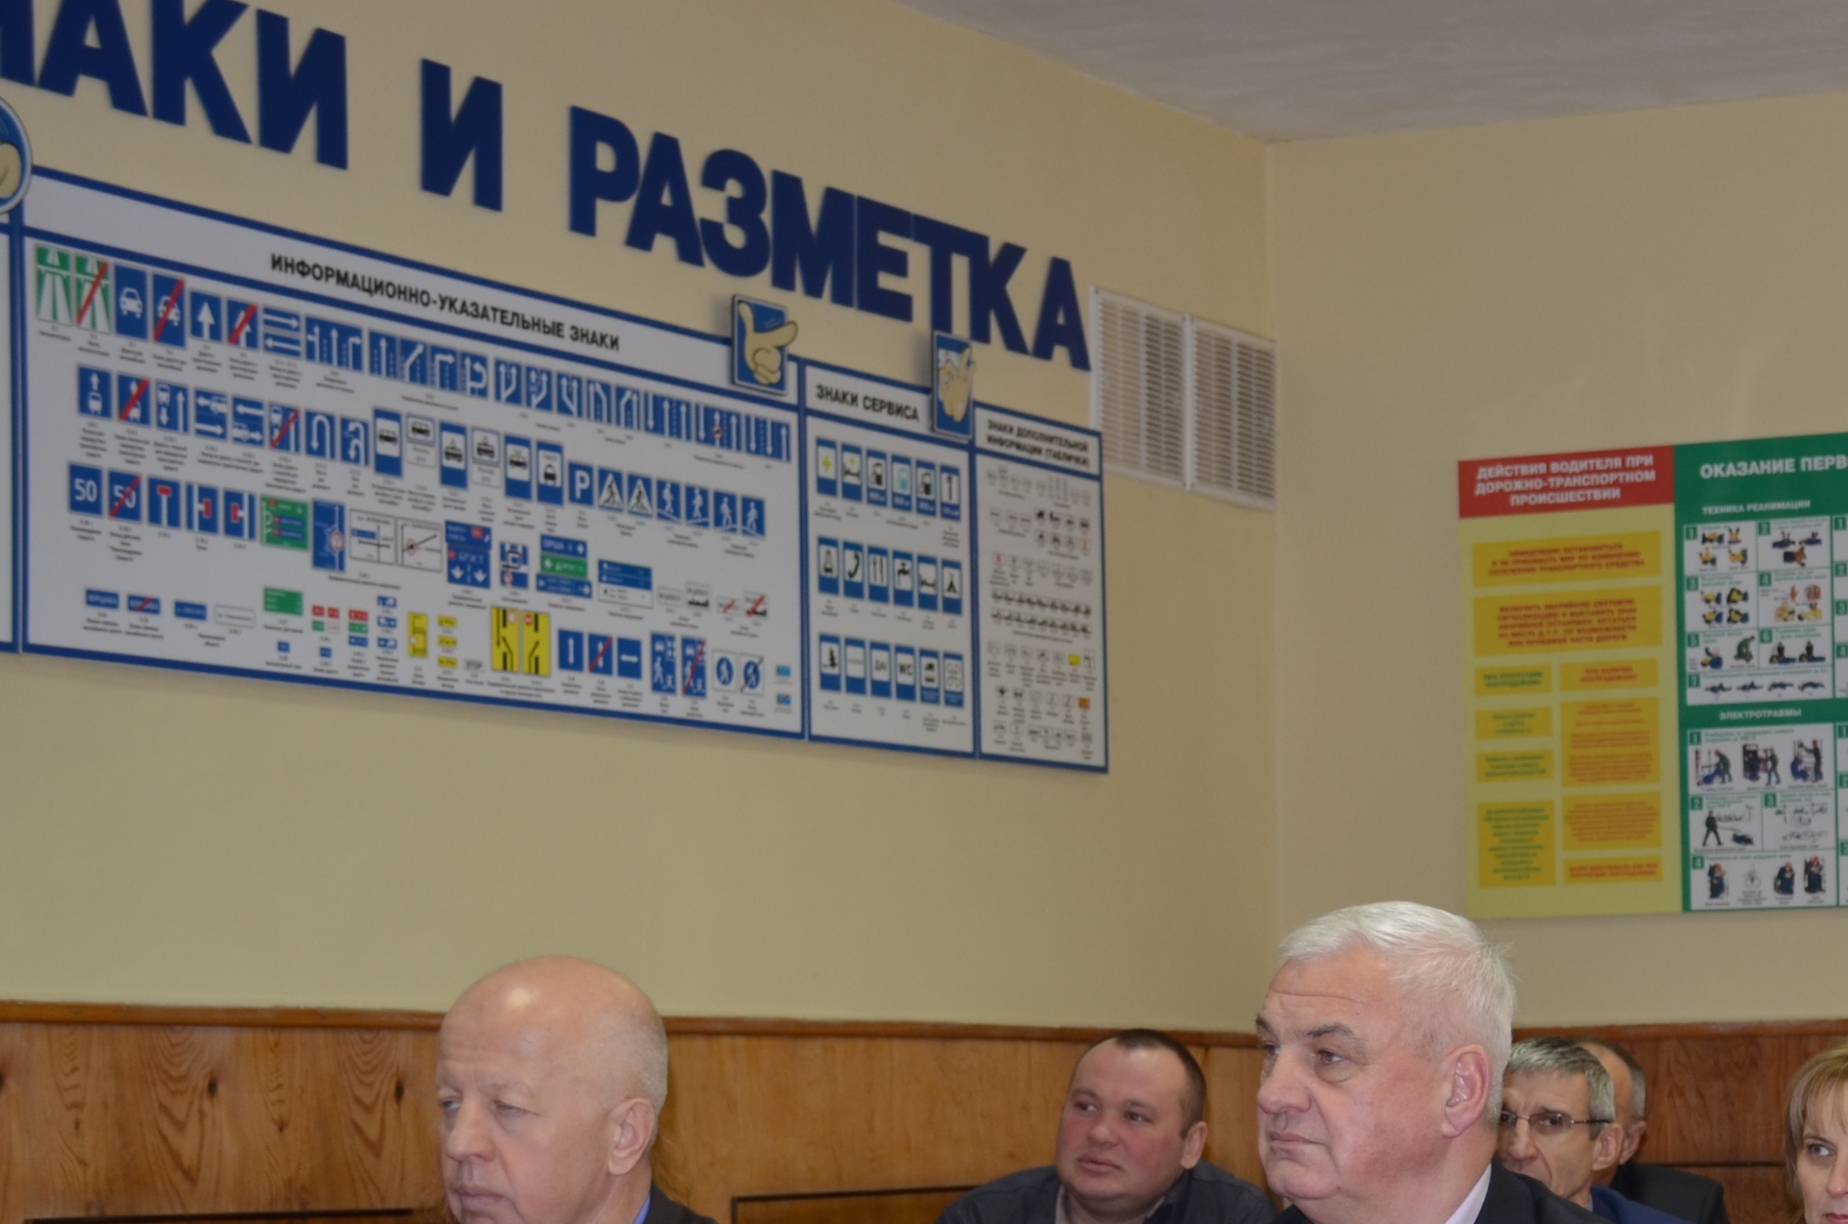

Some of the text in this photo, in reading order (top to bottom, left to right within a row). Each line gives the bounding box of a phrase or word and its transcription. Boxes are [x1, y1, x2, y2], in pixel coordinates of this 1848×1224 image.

[420, 58, 503, 213] И
[568, 104, 1091, 373] РАЗМЕТКА
[269, 252, 621, 352] ИНФОРМАЦИОННО-УКАЗАТЕЛЬНЫЕ ЗНАКИ
[816, 384, 919, 422] ЗНАКИ СЕРВИСА
[987, 420, 1089, 454] ЗНАКИ ДОПОЛНИТЕЛЬНОЙ
[987, 435, 1090, 469] ИНФОРМАЦИИ (ТАБЛИЧКИ)
[1477, 455, 1653, 480] ДЕЙСТВИЯ ВОДИТЕЛЯ ПРИ
[1700, 459, 1795, 479] ОКАЗАНИЕ
[74, 478, 98, 502] 50
[1475, 471, 1656, 495] ДОРОЖНО-ТРАНСПОРТНОМ
[1510, 488, 1620, 506] ПРОИСШЕСТВИИ
[1703, 500, 1811, 515] ТЕХНИКА РЕАНИМАЦИИ
[899, 664, 913, 676] WC
[1720, 709, 1802, 721] ЭЛЕКТРОТРАВМЫ
